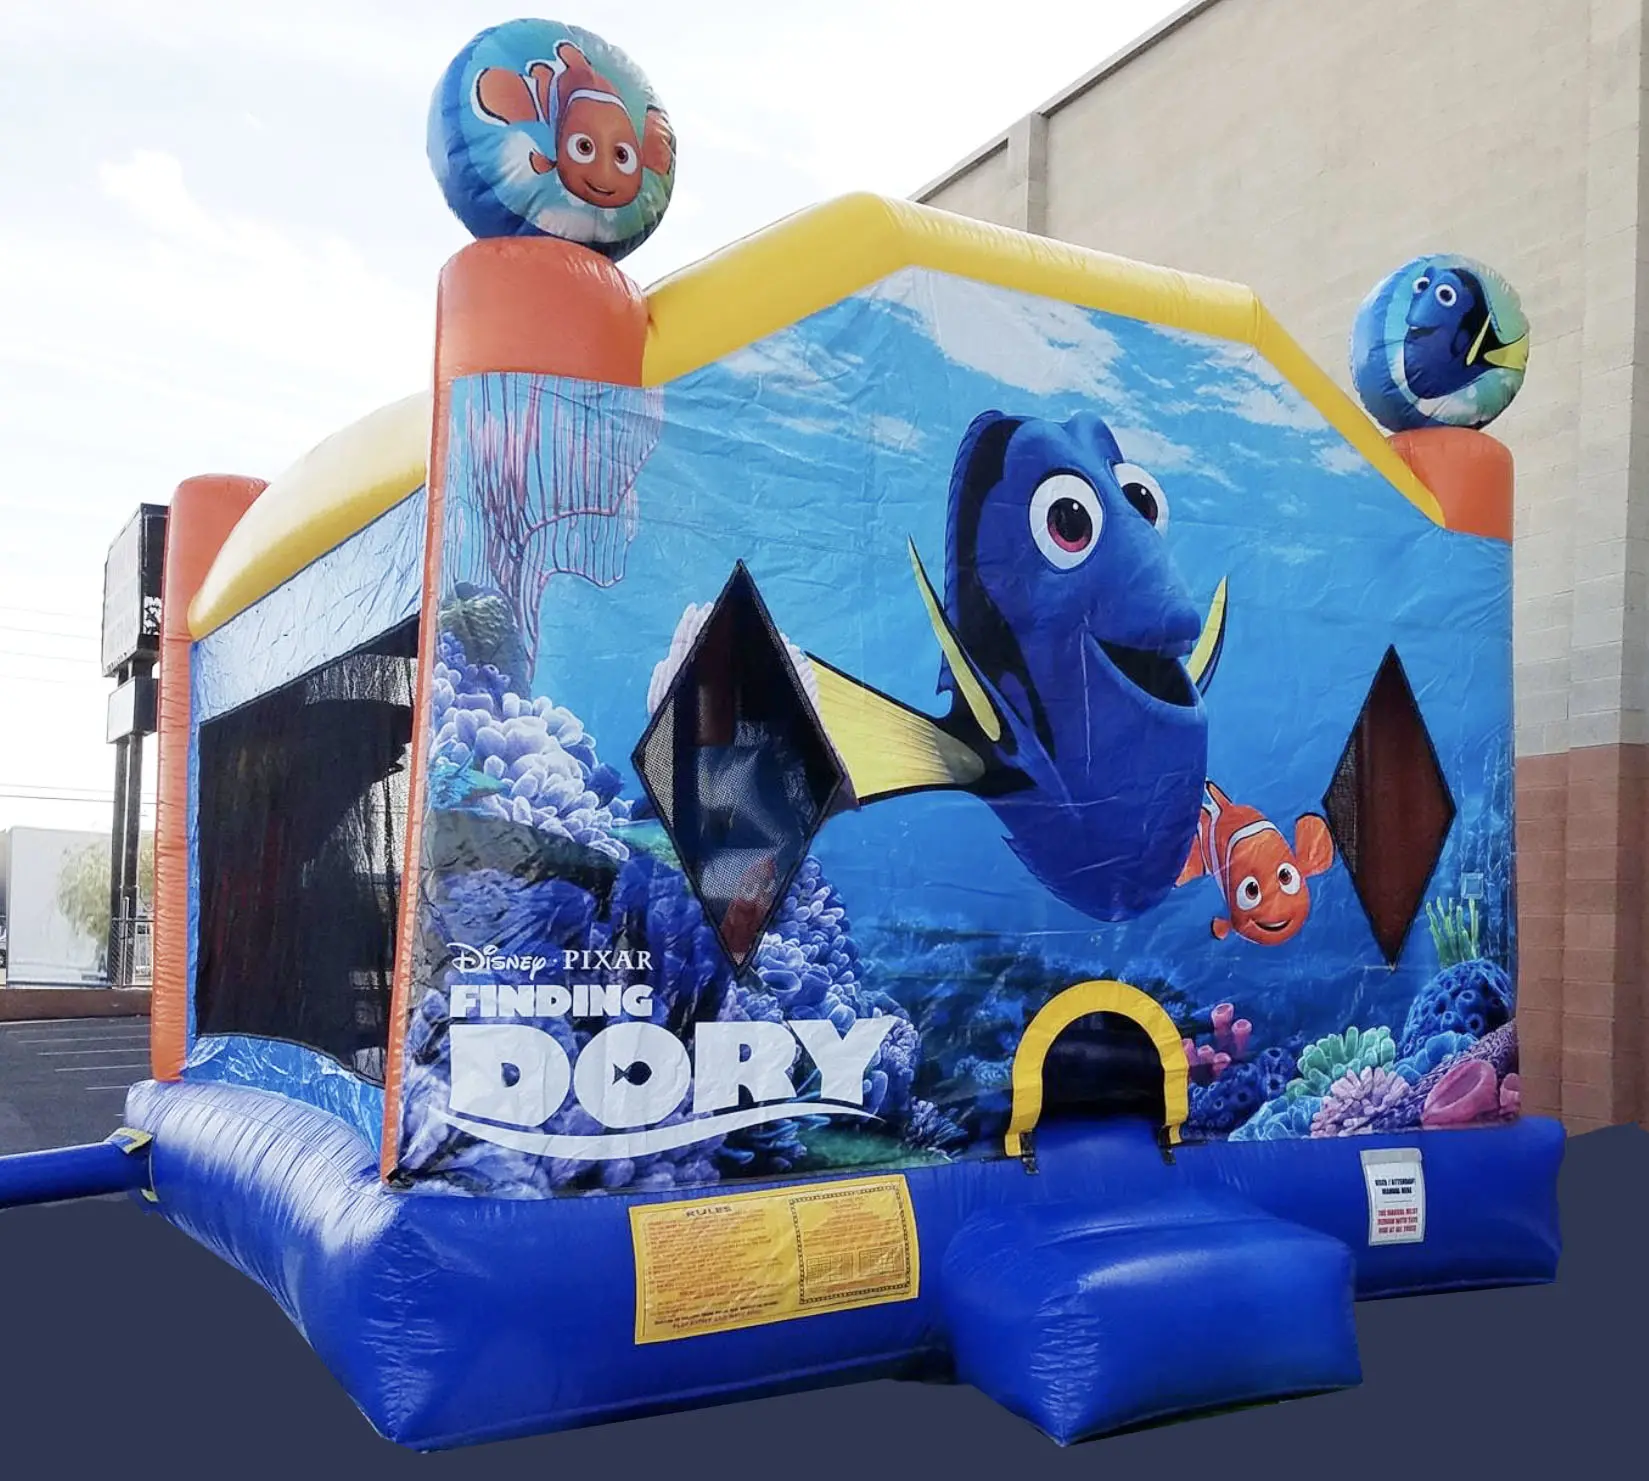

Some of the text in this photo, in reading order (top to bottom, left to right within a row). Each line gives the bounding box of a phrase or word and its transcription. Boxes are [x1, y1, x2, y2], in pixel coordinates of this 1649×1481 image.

[562, 949, 654, 971] PIXAR
[449, 984, 654, 1018] FINDING
[448, 1015, 895, 1129] DORY
[685, 1205, 733, 1218] RULES
